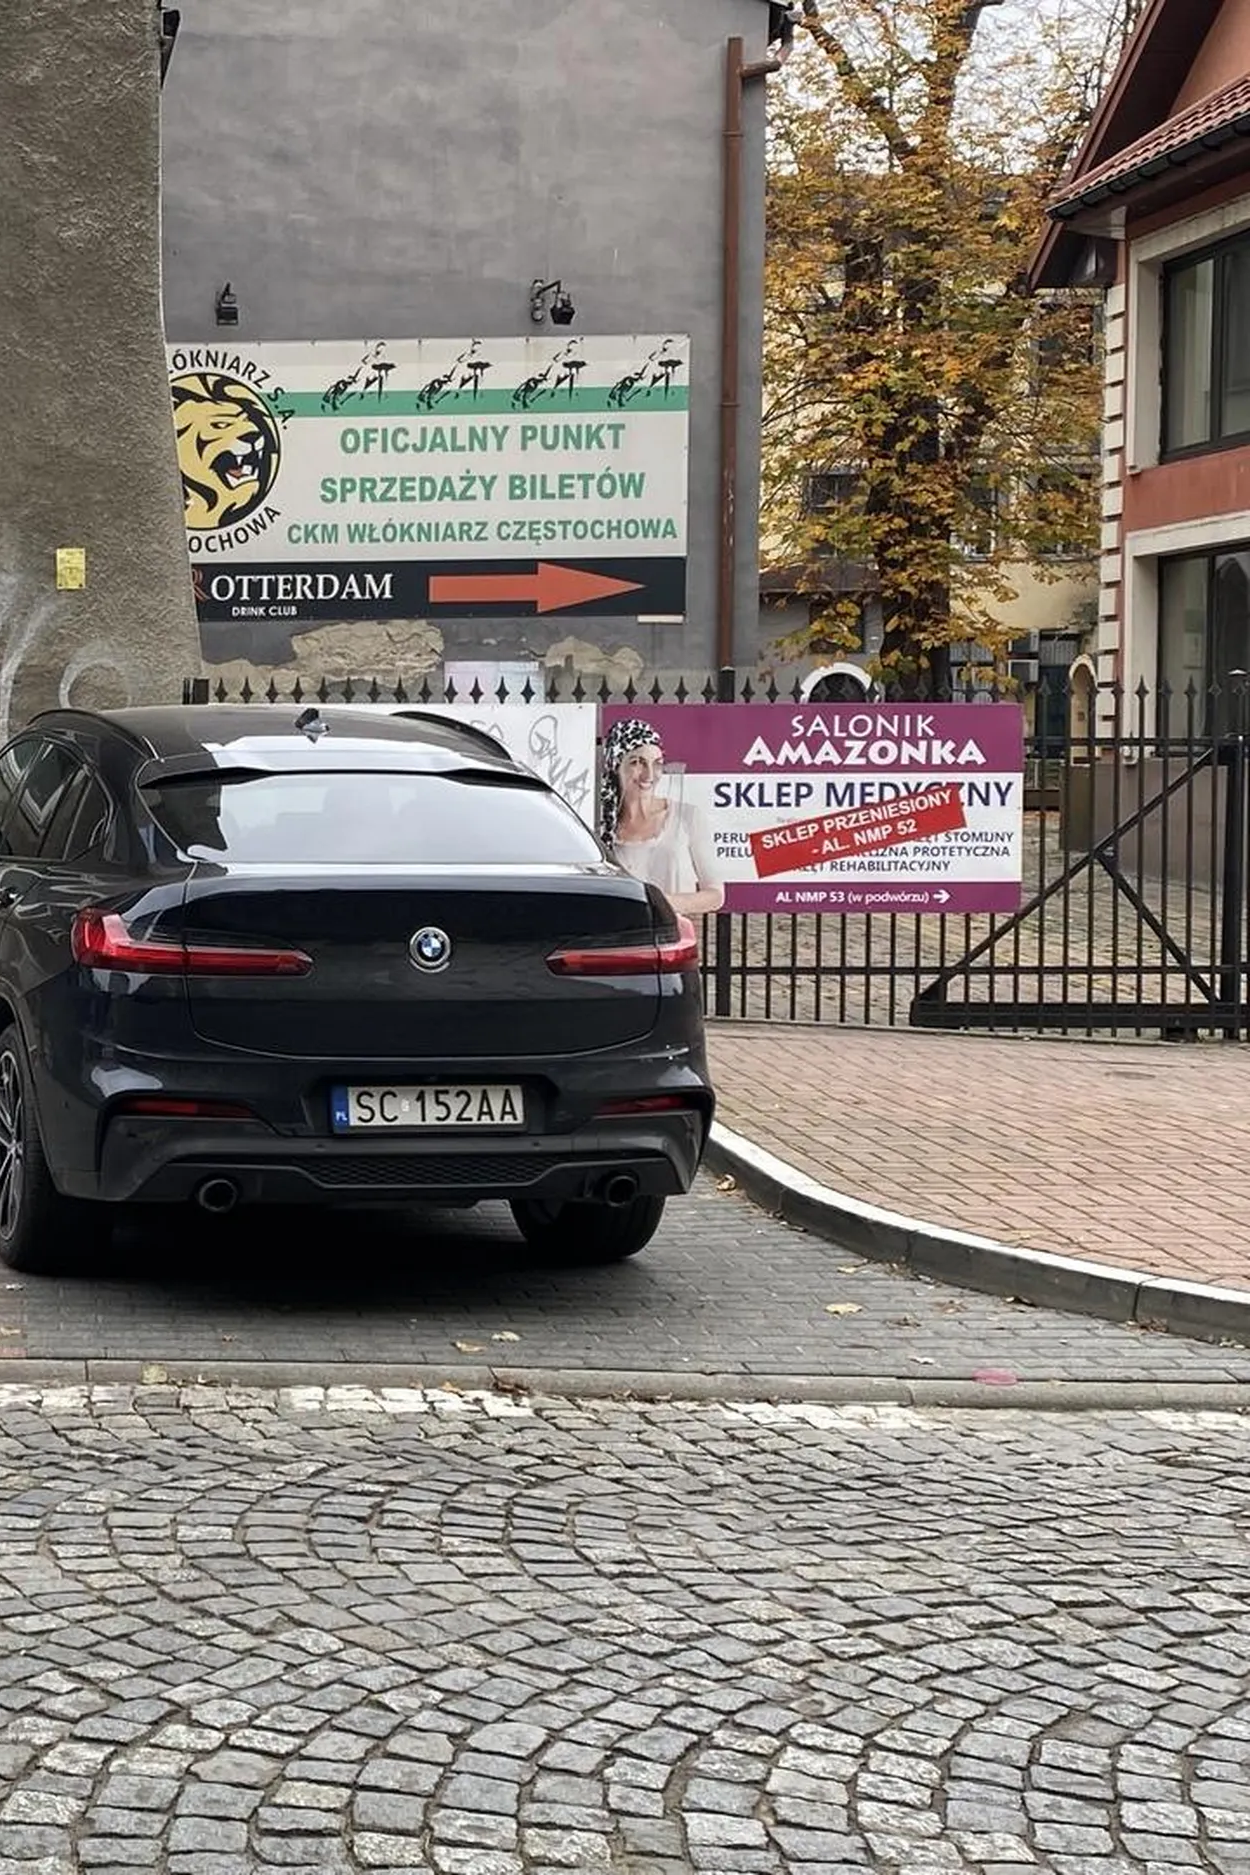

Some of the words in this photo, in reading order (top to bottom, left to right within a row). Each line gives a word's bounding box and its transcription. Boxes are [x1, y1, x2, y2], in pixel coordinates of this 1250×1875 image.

[169, 349, 271, 389] ÓKNIARZ
[340, 425, 510, 454] OFICJALNY
[520, 423, 626, 450] PUNKT
[319, 468, 498, 503] SPRZEDAŻY
[508, 467, 646, 500] BILETÓW
[287, 523, 339, 544] CKM
[347, 517, 488, 543] WŁÓKNIARZ
[496, 518, 678, 546] CZĘSTOCHOWA
[232, 607, 266, 617] DRINK
[268, 606, 298, 616] CLUB
[791, 714, 935, 738] SALONIK
[742, 735, 987, 766] AMAZONKA
[713, 782, 814, 808] SKLEP
[826, 781, 1014, 808] MEDYNY
[761, 823, 820, 850] SKLEP
[823, 789, 952, 835] PRZENIESIONY
[853, 825, 893, 847] NMP
[897, 818, 918, 835] 52
[714, 832, 751, 844] PERU
[913, 846, 1010, 858] PROTETYCZNA
[830, 860, 950, 873] REHABILITACYJNY
[776, 891, 792, 903] AL
[795, 891, 827, 903] NMP
[829, 891, 845, 903] 53
[355, 1090, 399, 1123] SC
[414, 1088, 518, 1122] 152AA
